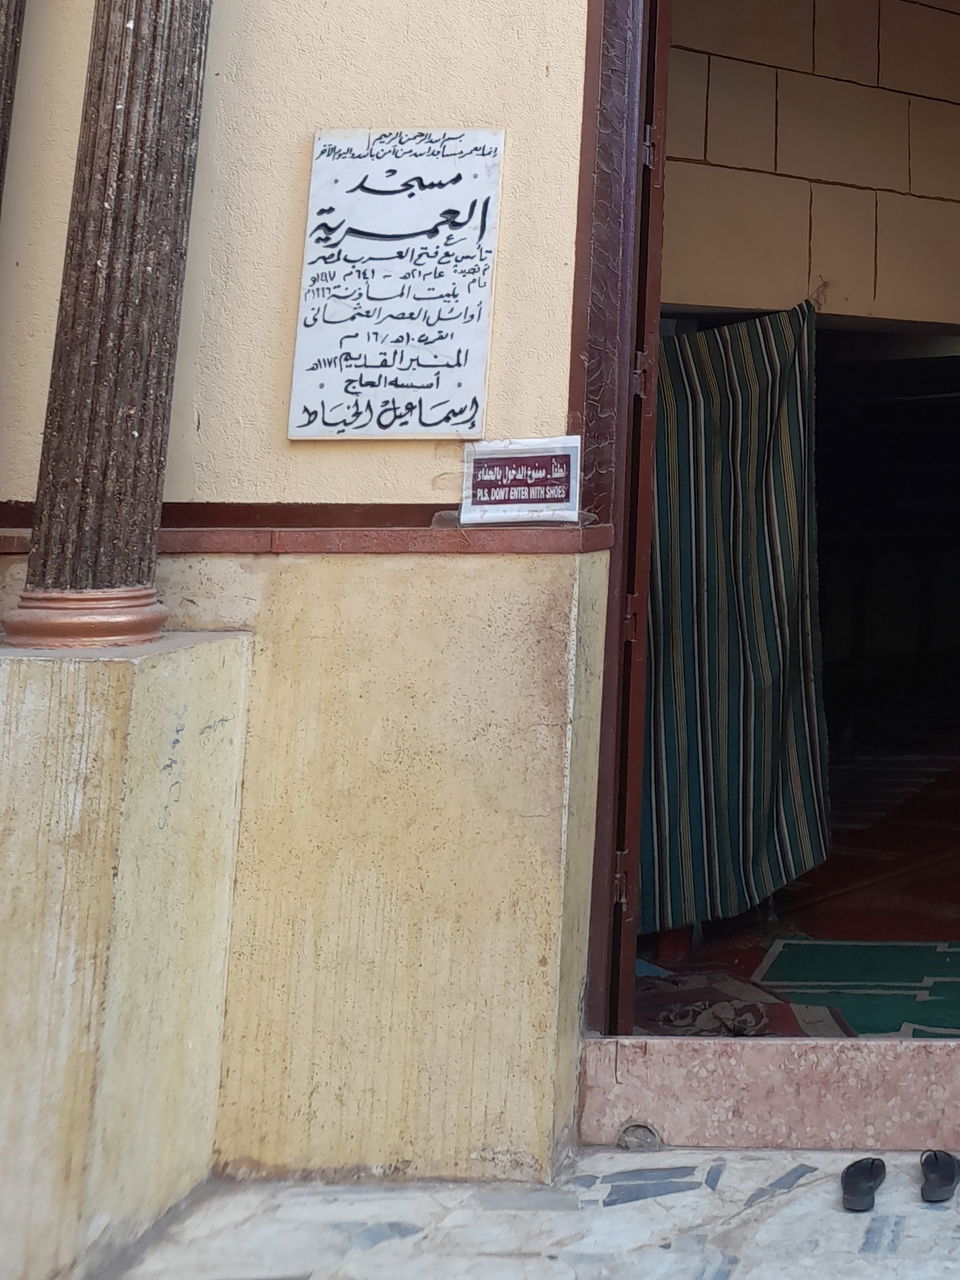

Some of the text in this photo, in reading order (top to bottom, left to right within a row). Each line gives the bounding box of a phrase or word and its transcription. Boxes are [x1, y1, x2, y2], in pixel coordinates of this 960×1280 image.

[372, 131, 402, 146] الرحيم
[398, 131, 432, 145] الرحمن
[395, 148, 413, 159] من
[409, 146, 431, 158] الله
[427, 145, 463, 159] مساجد
[458, 146, 482, 159] يعمر
[345, 169, 462, 198] مسجد
[309, 196, 491, 248] العمرية
[307, 249, 342, 265] لمصر
[343, 247, 415, 268] العرب
[413, 245, 440, 266] فتح
[437, 251, 455, 264] مع
[423, 267, 445, 281] عام
[375, 305, 428, 325] العصر
[426, 300, 482, 326] أوائل
[417, 330, 454, 345] القرن
[339, 349, 404, 372] القديم
[396, 348, 469, 371] المنبر
[344, 373, 388, 394] الحاج
[296, 396, 479, 434] إسماعيل الخياط
[477, 464, 502, 485] بالحذاء
[502, 464, 527, 485] الدخول
[527, 463, 545, 484] ممنوع
[510, 487, 528, 499] ENTER
[530, 486, 544, 499] WITH
[546, 485, 565, 498] SHOES
